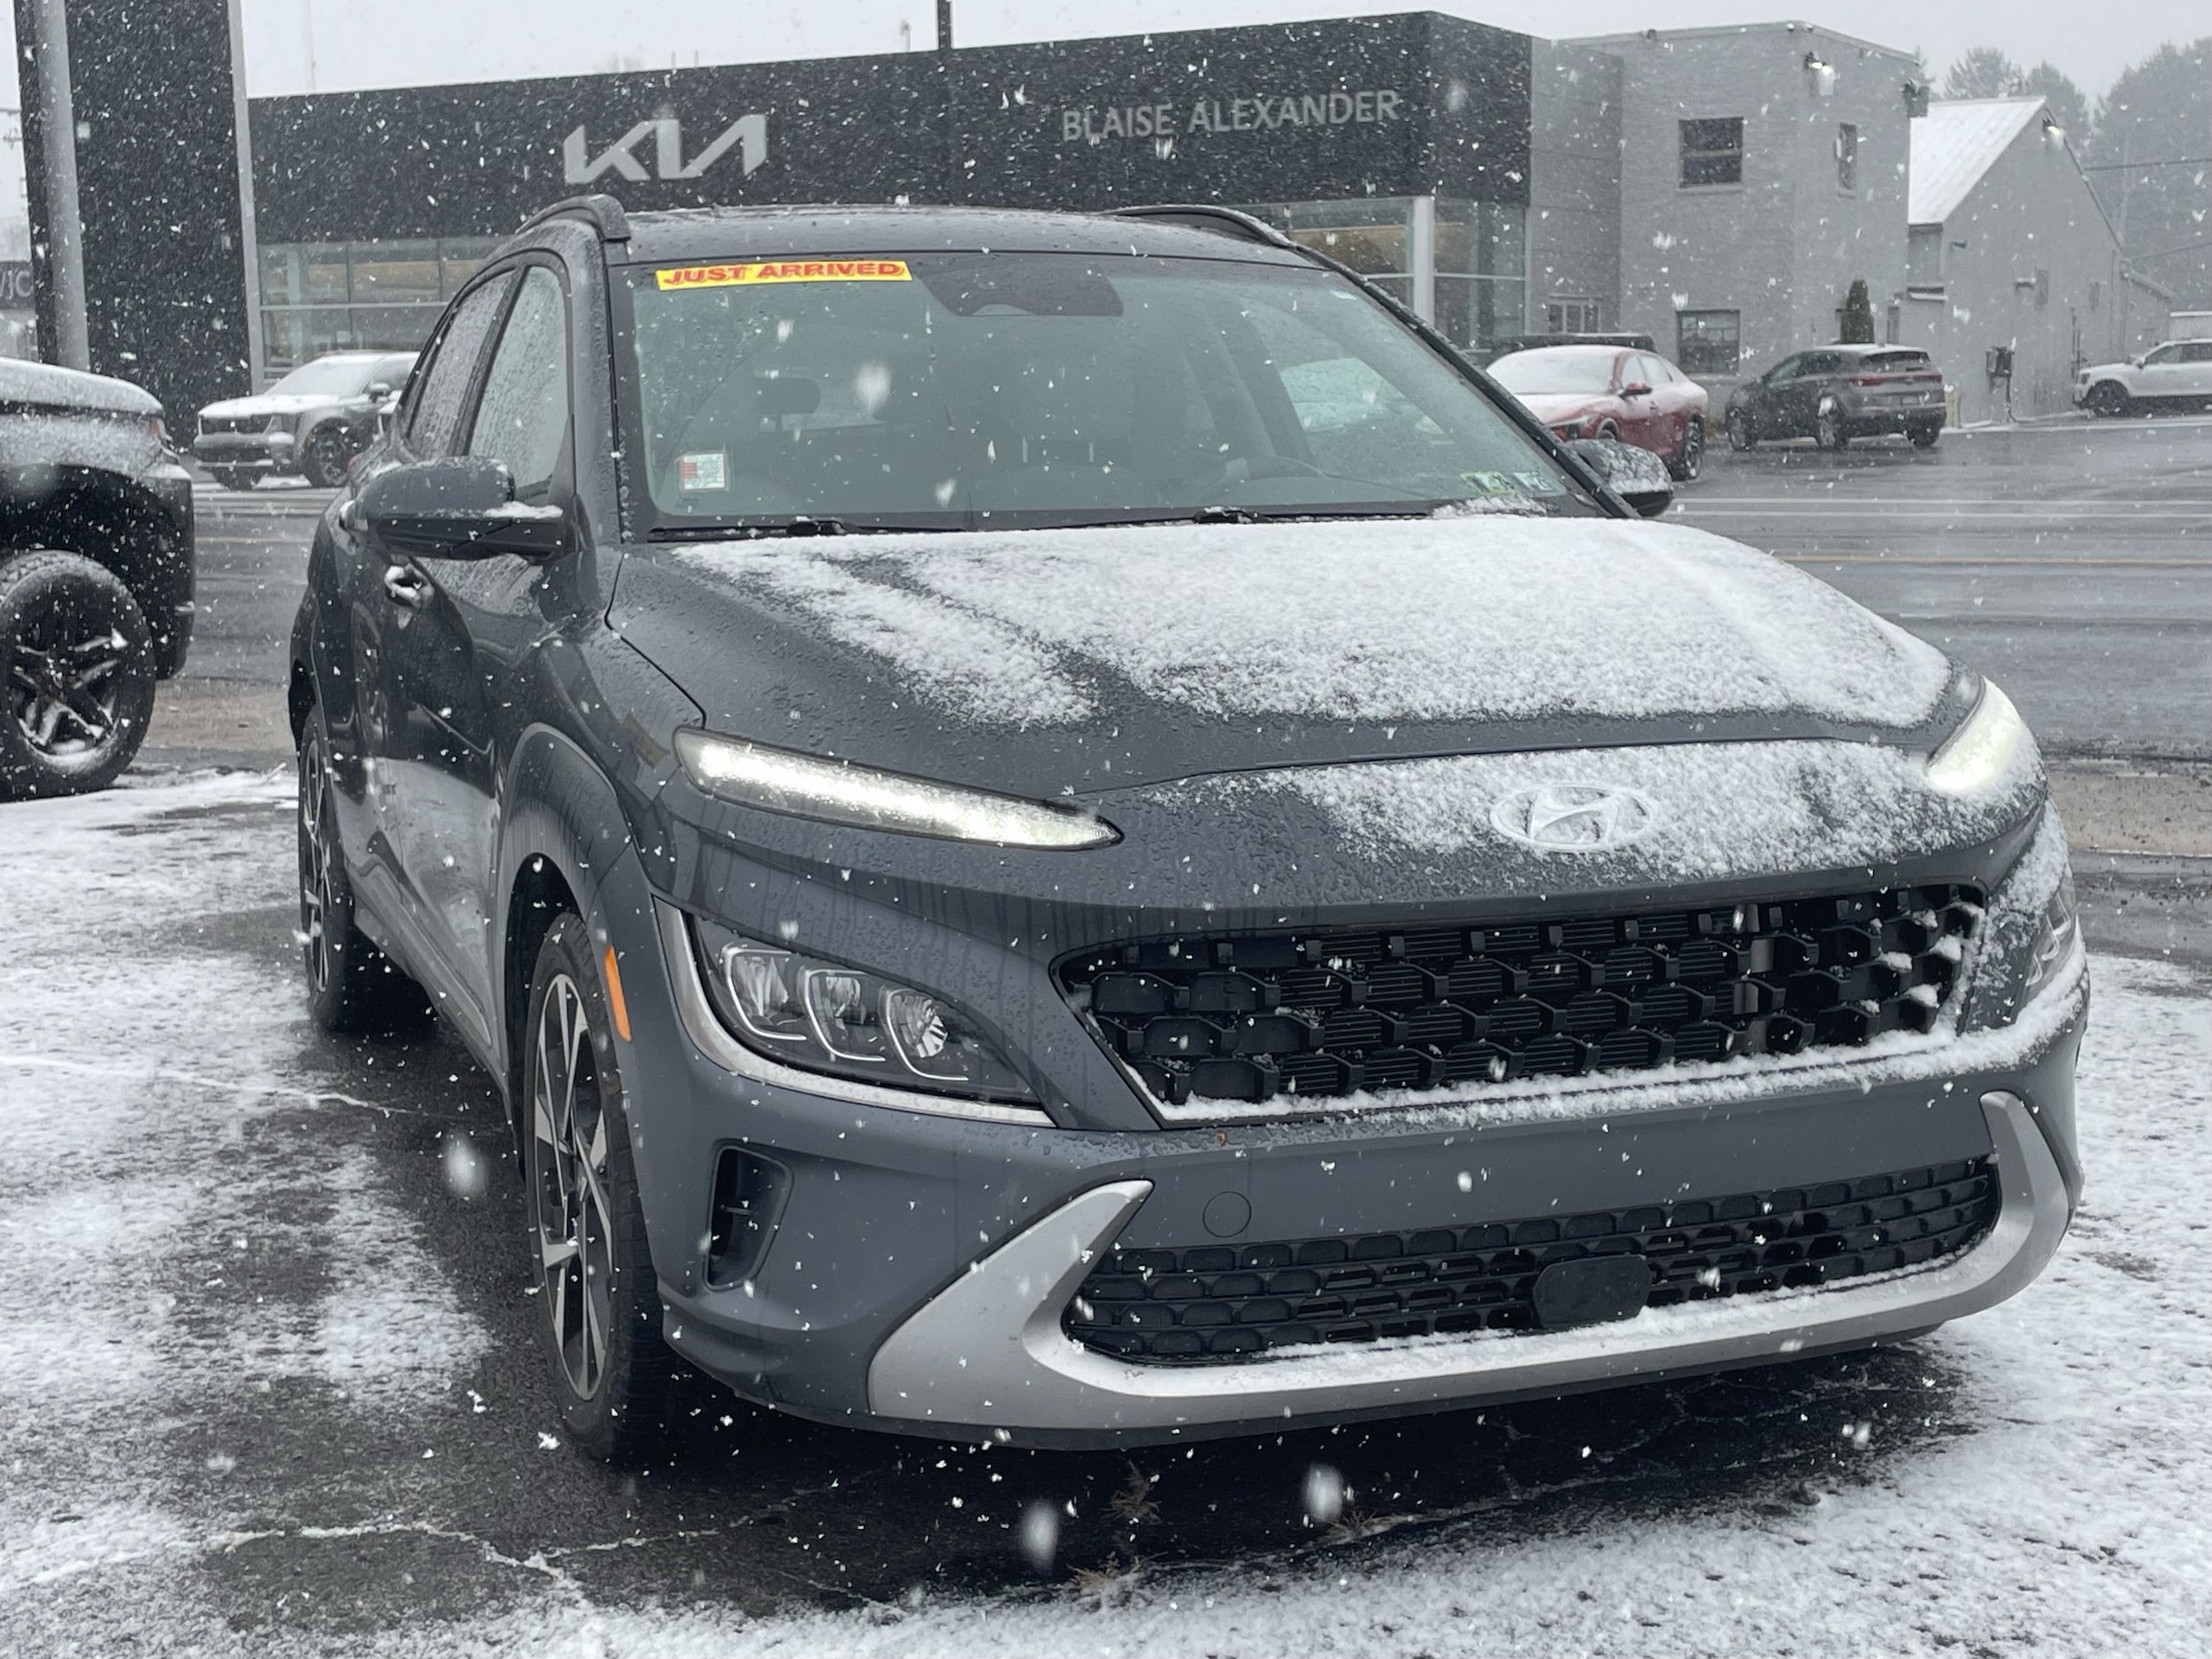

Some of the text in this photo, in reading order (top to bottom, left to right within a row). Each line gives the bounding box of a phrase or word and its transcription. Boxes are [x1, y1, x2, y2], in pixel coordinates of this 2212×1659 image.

[1063, 90, 1400, 142] BLAISE ALEXANDER
[564, 114, 767, 184] KIA
[664, 262, 904, 285] JUST ARRIVED
